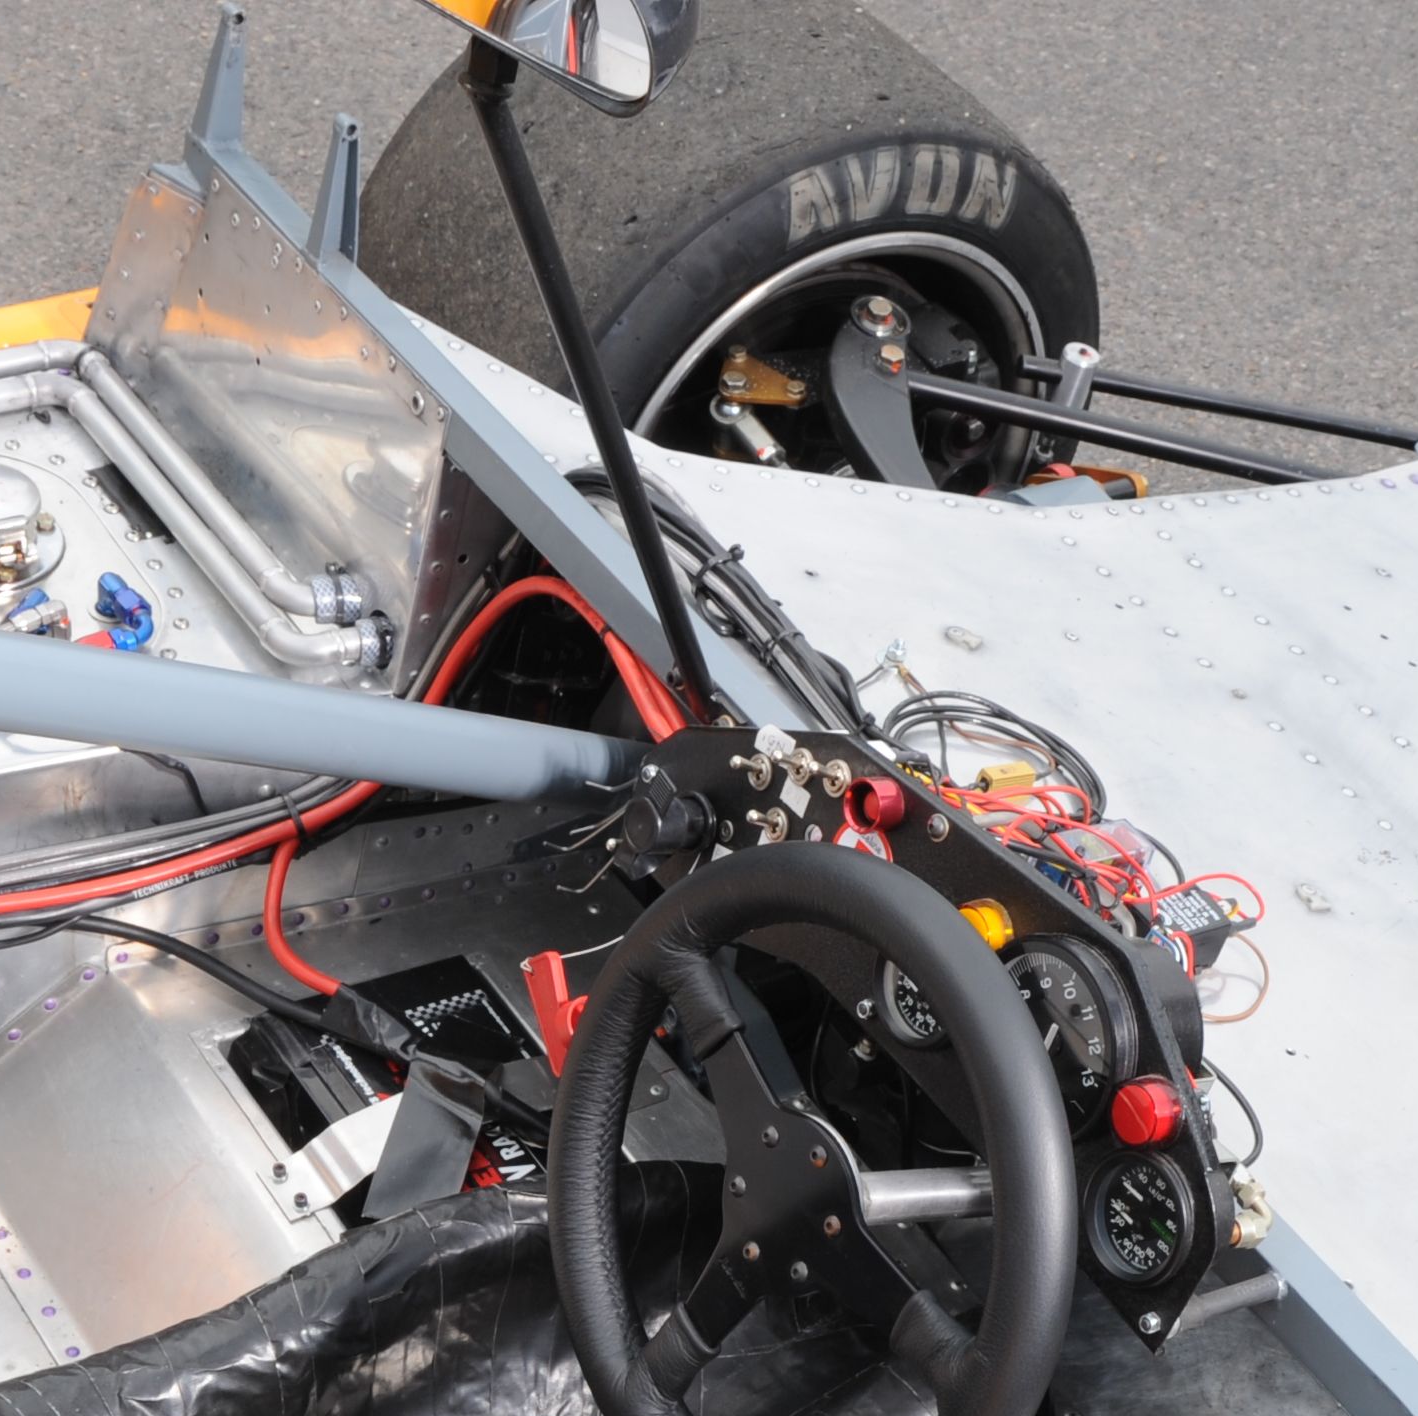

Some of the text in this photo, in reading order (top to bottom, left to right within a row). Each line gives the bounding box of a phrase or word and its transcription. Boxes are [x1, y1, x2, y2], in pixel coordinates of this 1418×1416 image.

[787, 145, 1017, 249] AVON
[132, 874, 190, 899] TECHNIKRAFT
[1040, 977, 1052, 989] 9
[1062, 980, 1076, 999] 10
[1081, 1006, 1094, 1021] 11
[1087, 1036, 1102, 1055] 12
[1081, 1068, 1095, 1088] 13
